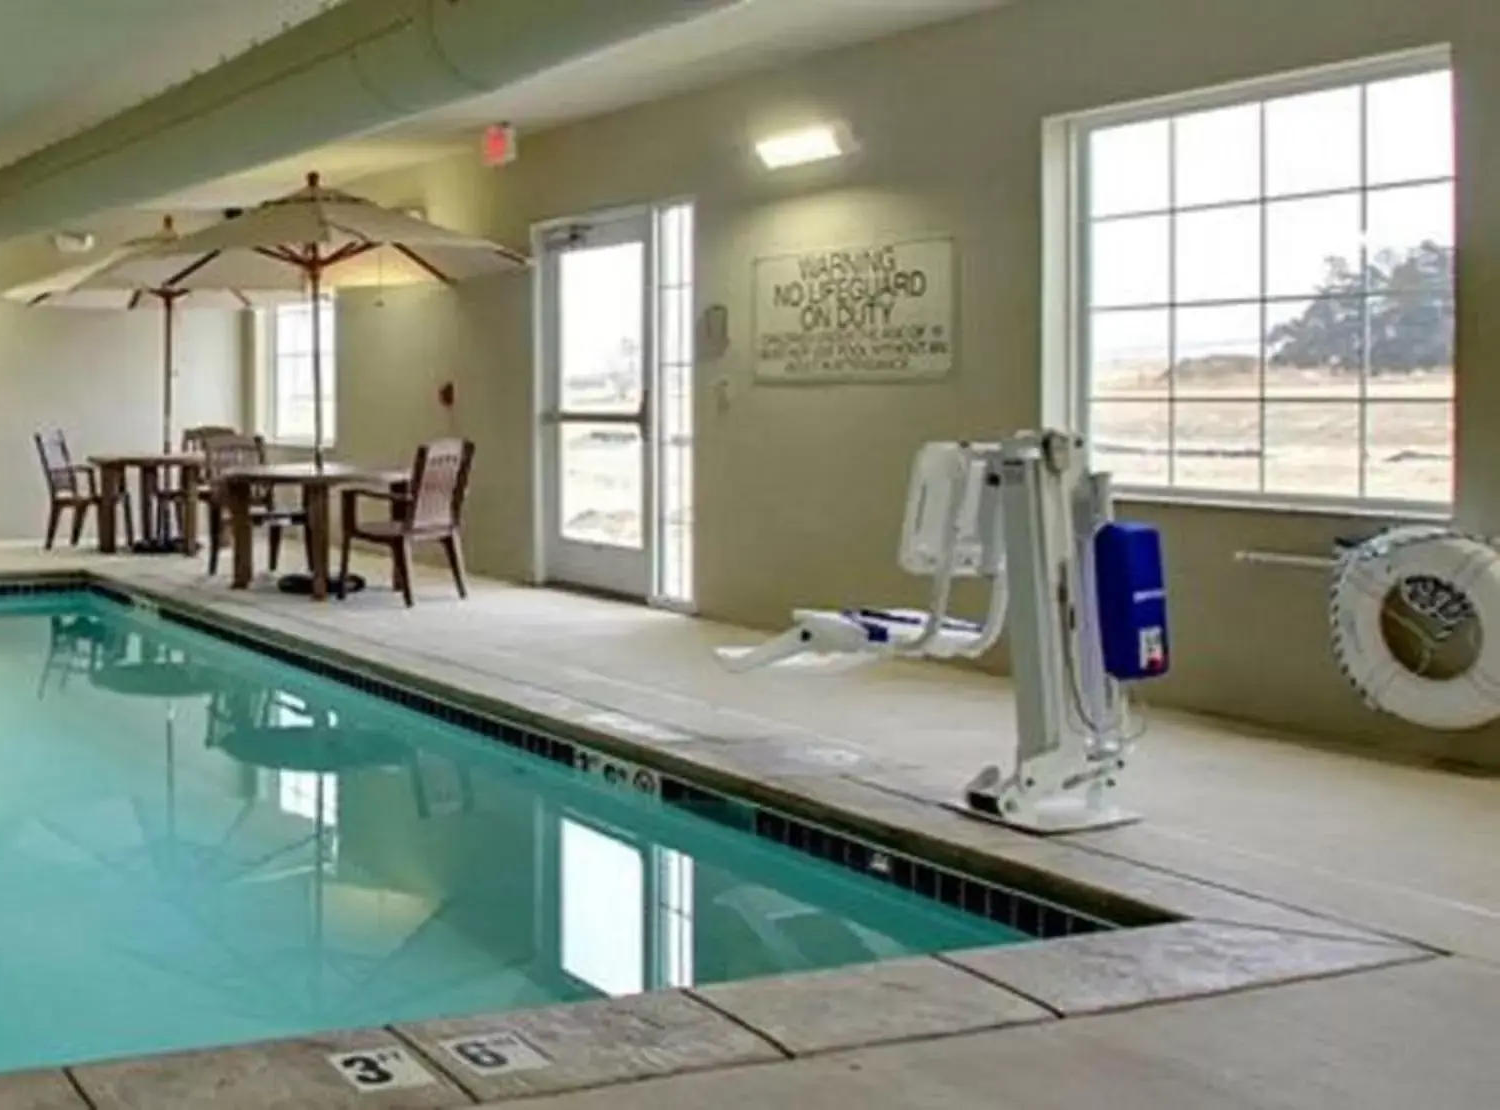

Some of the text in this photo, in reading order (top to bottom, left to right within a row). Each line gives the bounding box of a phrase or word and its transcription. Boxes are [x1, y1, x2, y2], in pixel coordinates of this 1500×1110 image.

[798, 245, 896, 280] WARNING
[773, 269, 927, 308] NO LIFEGUARD
[801, 301, 896, 332] ON DUTY
[341, 1055, 394, 1085] 3
[454, 1041, 509, 1067] 6
